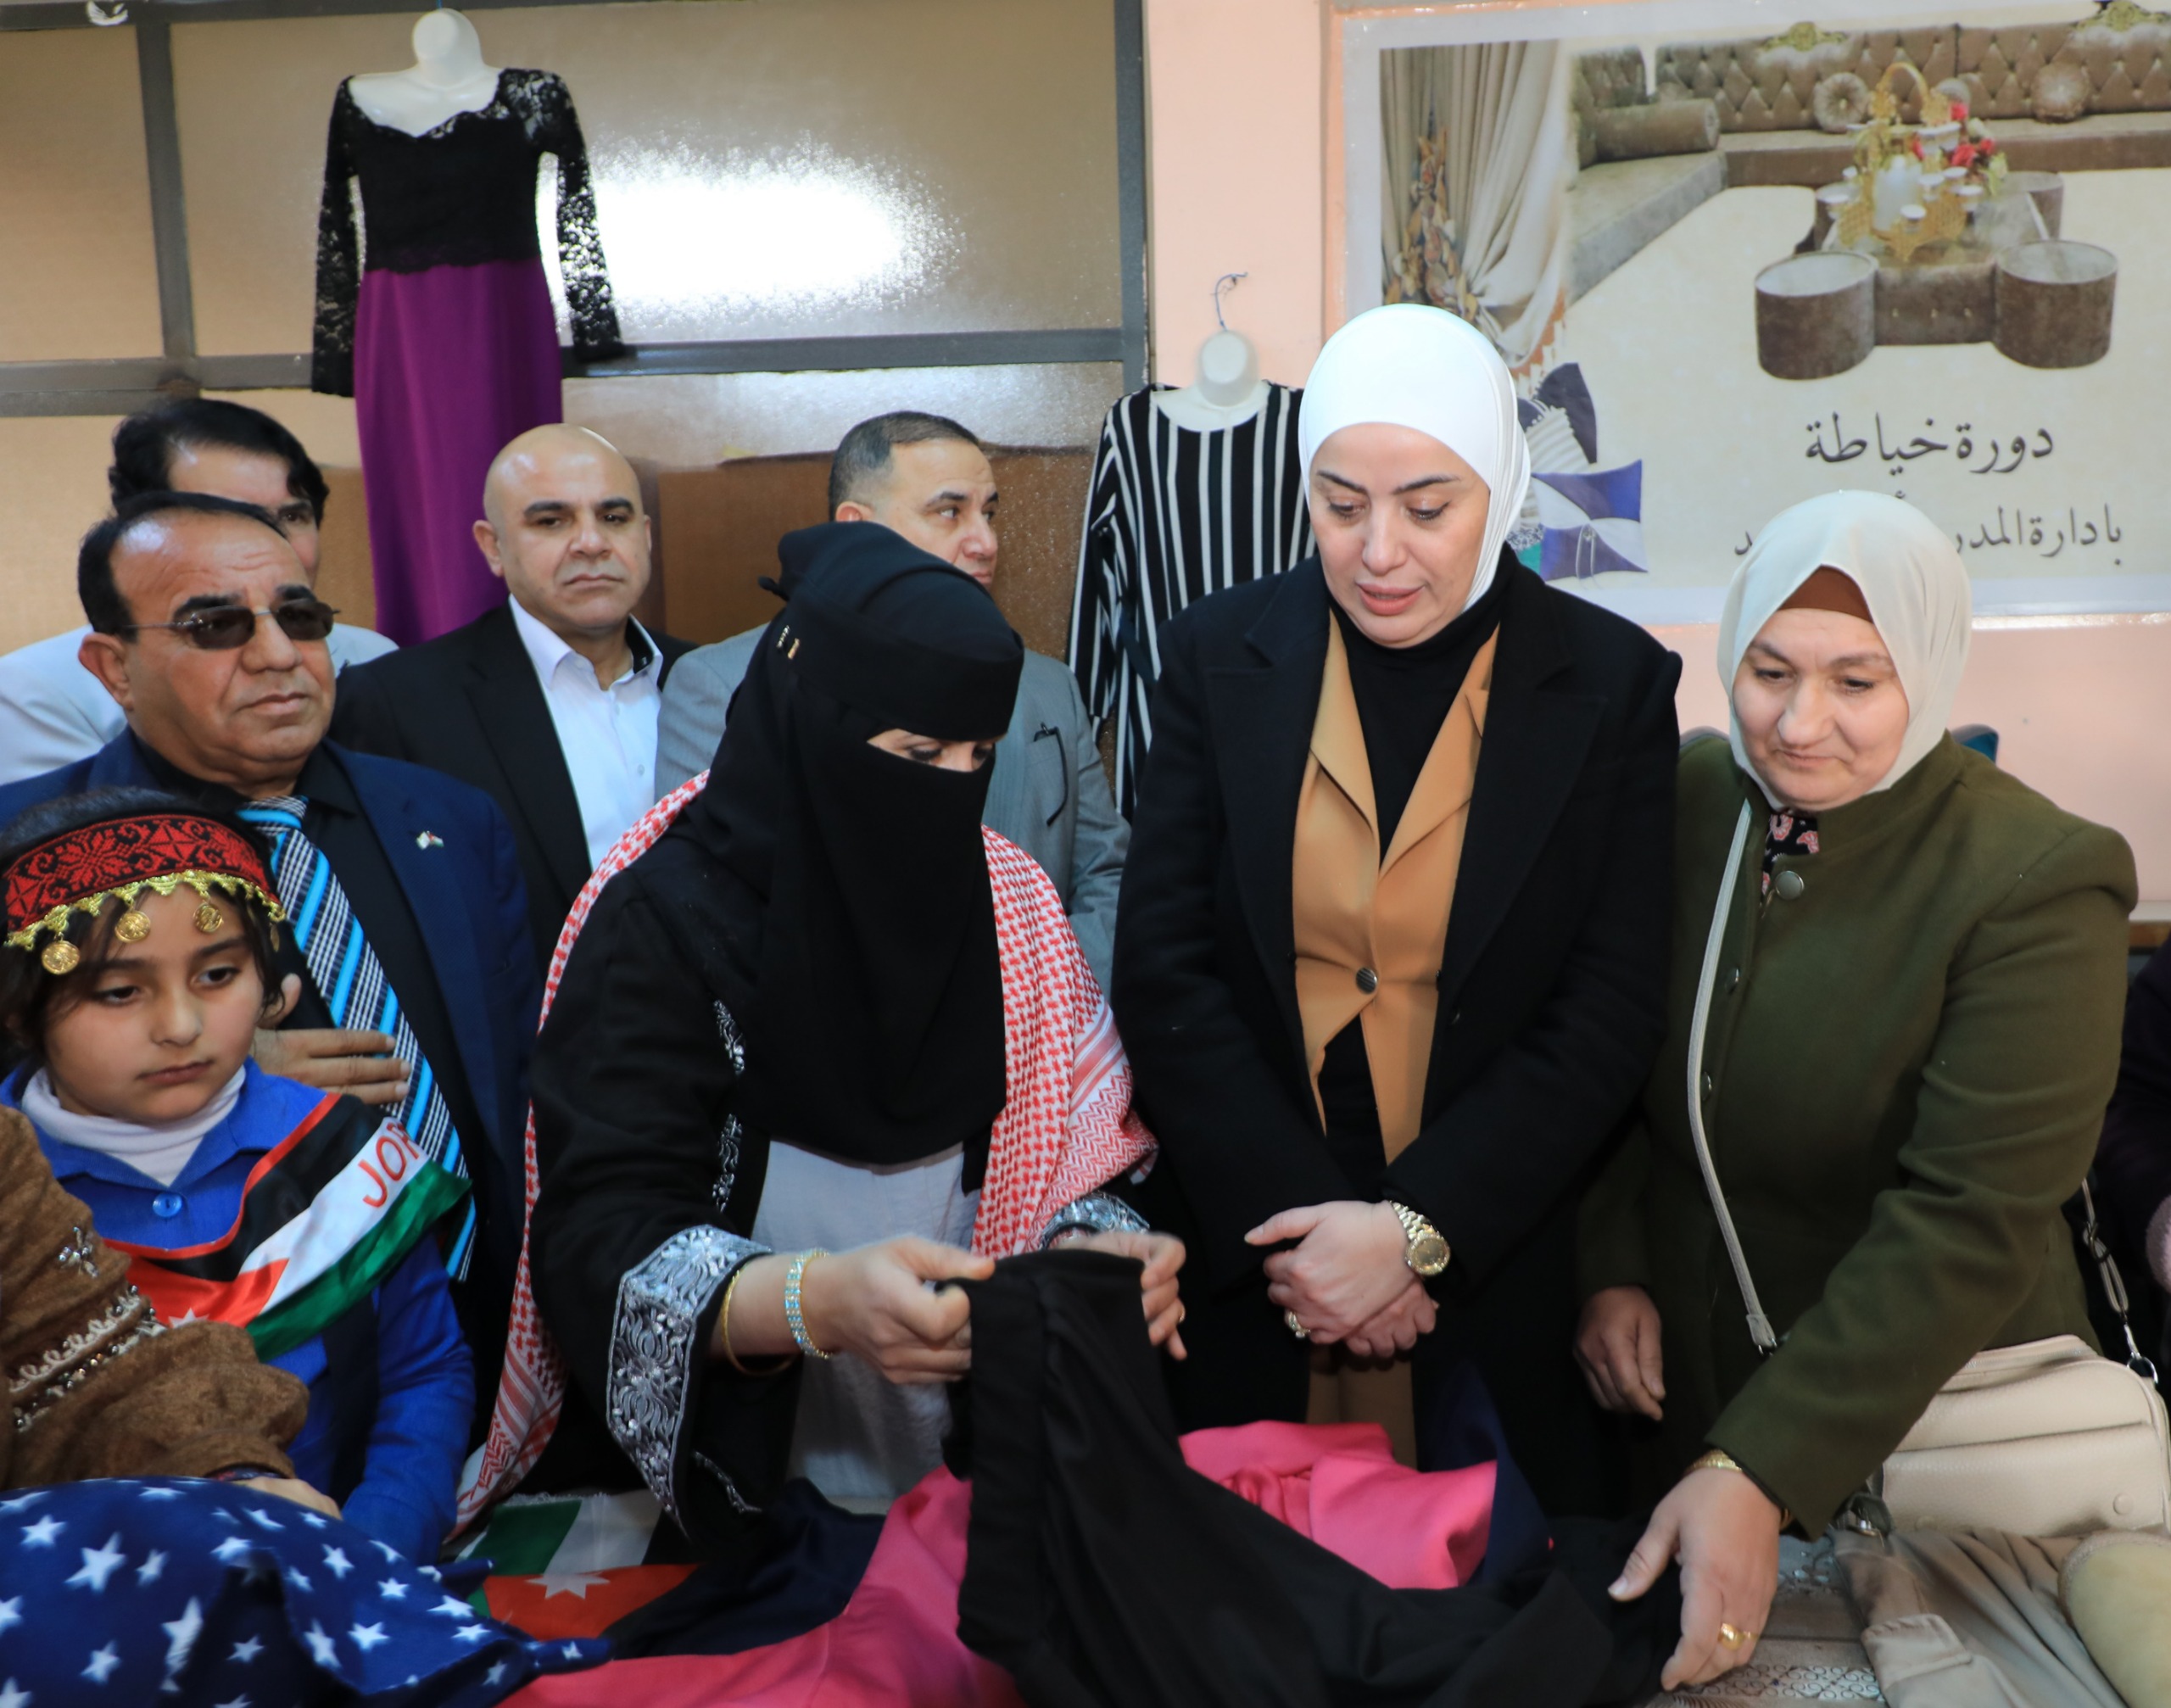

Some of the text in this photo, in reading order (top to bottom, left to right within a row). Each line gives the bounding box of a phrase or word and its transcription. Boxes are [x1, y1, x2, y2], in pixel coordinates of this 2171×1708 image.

[1805, 410, 2054, 476] دورة خياطة
[1955, 505, 2023, 554] المدر
